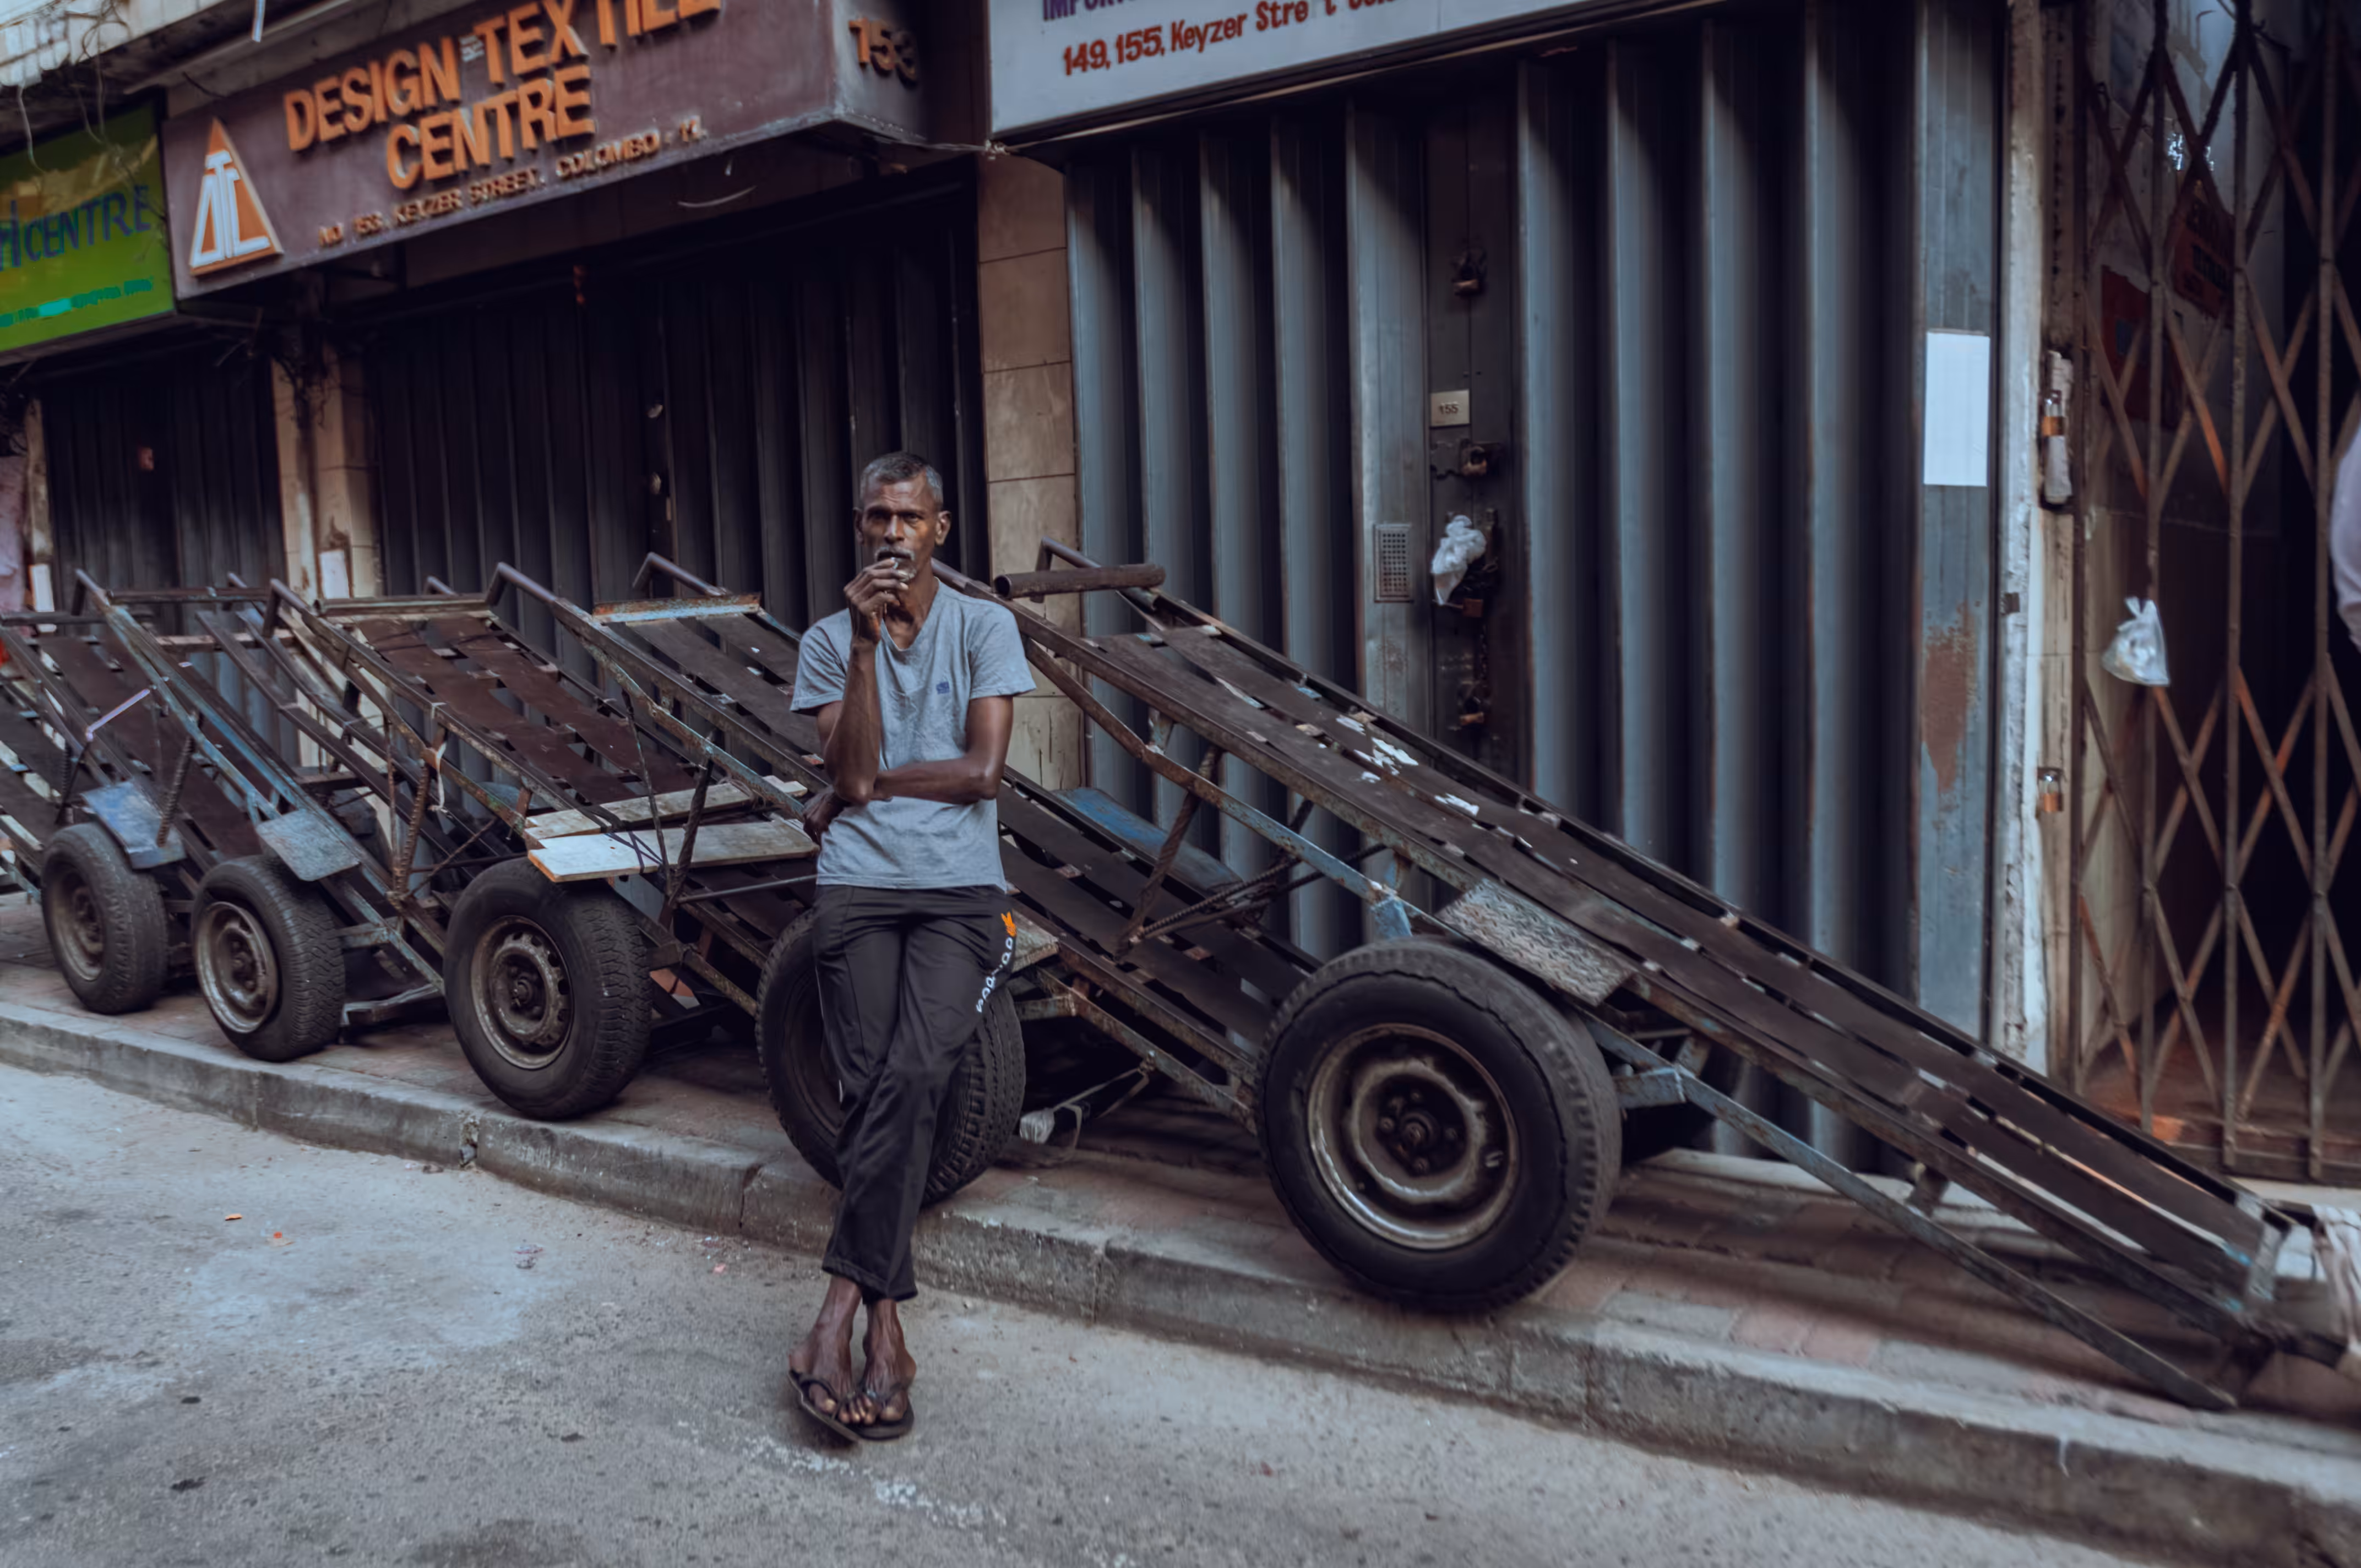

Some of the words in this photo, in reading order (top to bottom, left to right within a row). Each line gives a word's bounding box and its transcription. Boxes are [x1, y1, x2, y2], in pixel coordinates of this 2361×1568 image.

[284, 37, 461, 151] DESIGN
[473, 0, 721, 84] TEXTIL
[1063, 39, 1111, 76] 149,
[1116, 25, 1166, 64] 155,
[1171, 13, 1248, 53] Keyzer
[387, 65, 596, 189] CENTRE
[25, 184, 151, 262] CENTRE
